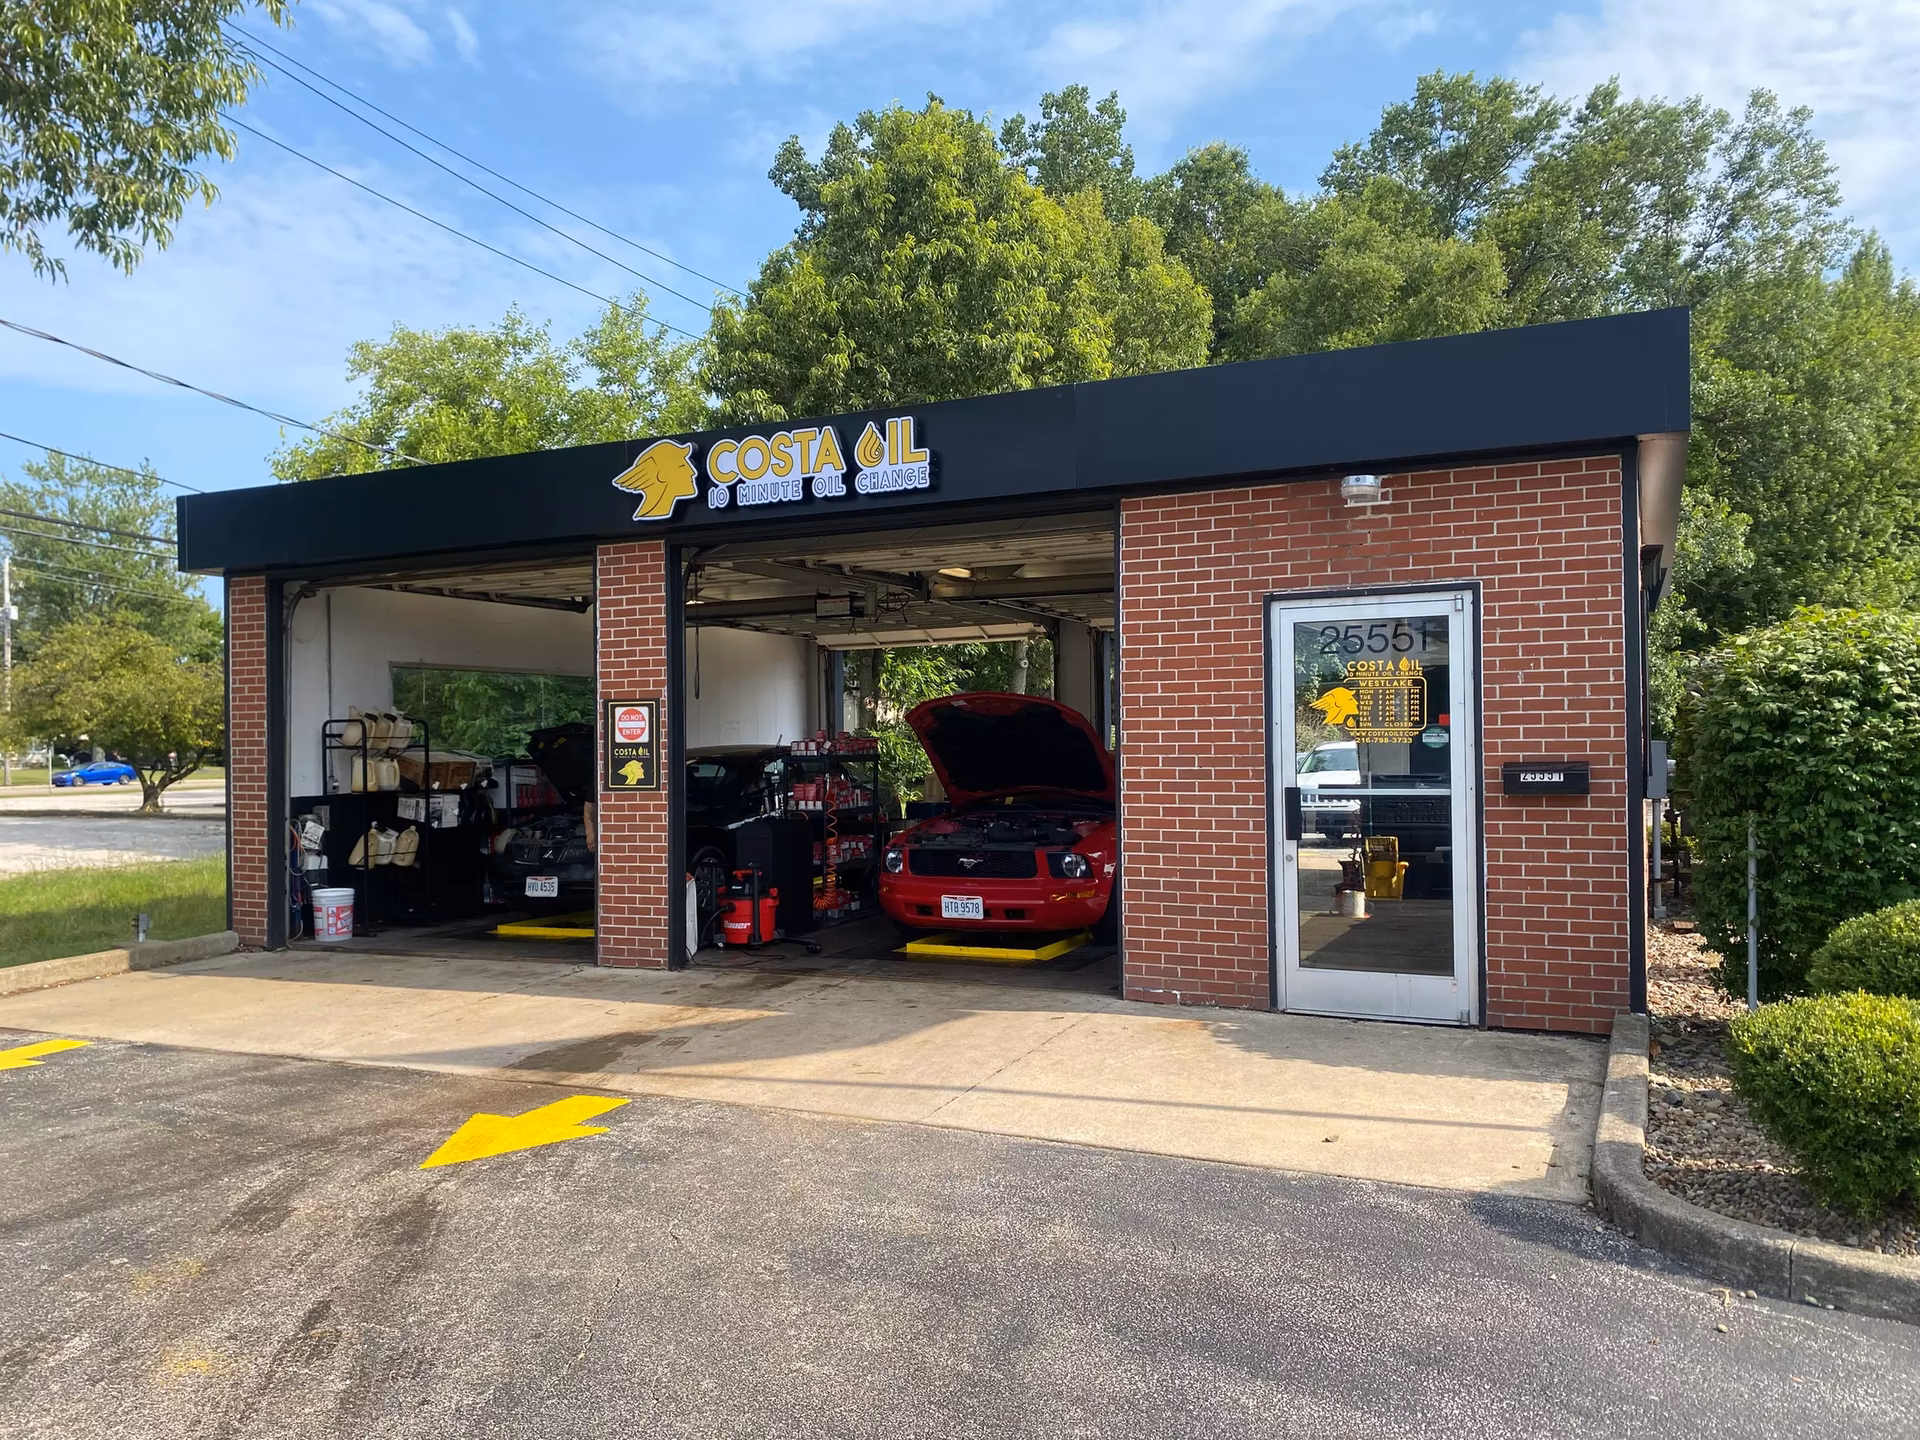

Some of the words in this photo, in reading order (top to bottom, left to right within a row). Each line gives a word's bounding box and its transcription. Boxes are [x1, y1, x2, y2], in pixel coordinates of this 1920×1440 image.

[708, 426, 845, 484] COSTA
[857, 418, 928, 468] OIL
[709, 487, 728, 507] 10
[738, 480, 801, 504] MINUTE
[813, 475, 844, 496] OIL
[856, 467, 928, 491] CHANGE
[1319, 622, 1427, 655] 25551
[1347, 660, 1395, 672] COSTA
[1399, 656, 1423, 671] OIL
[540, 882, 555, 892] 4535
[944, 901, 958, 913] HTB
[961, 902, 980, 913] 9578
